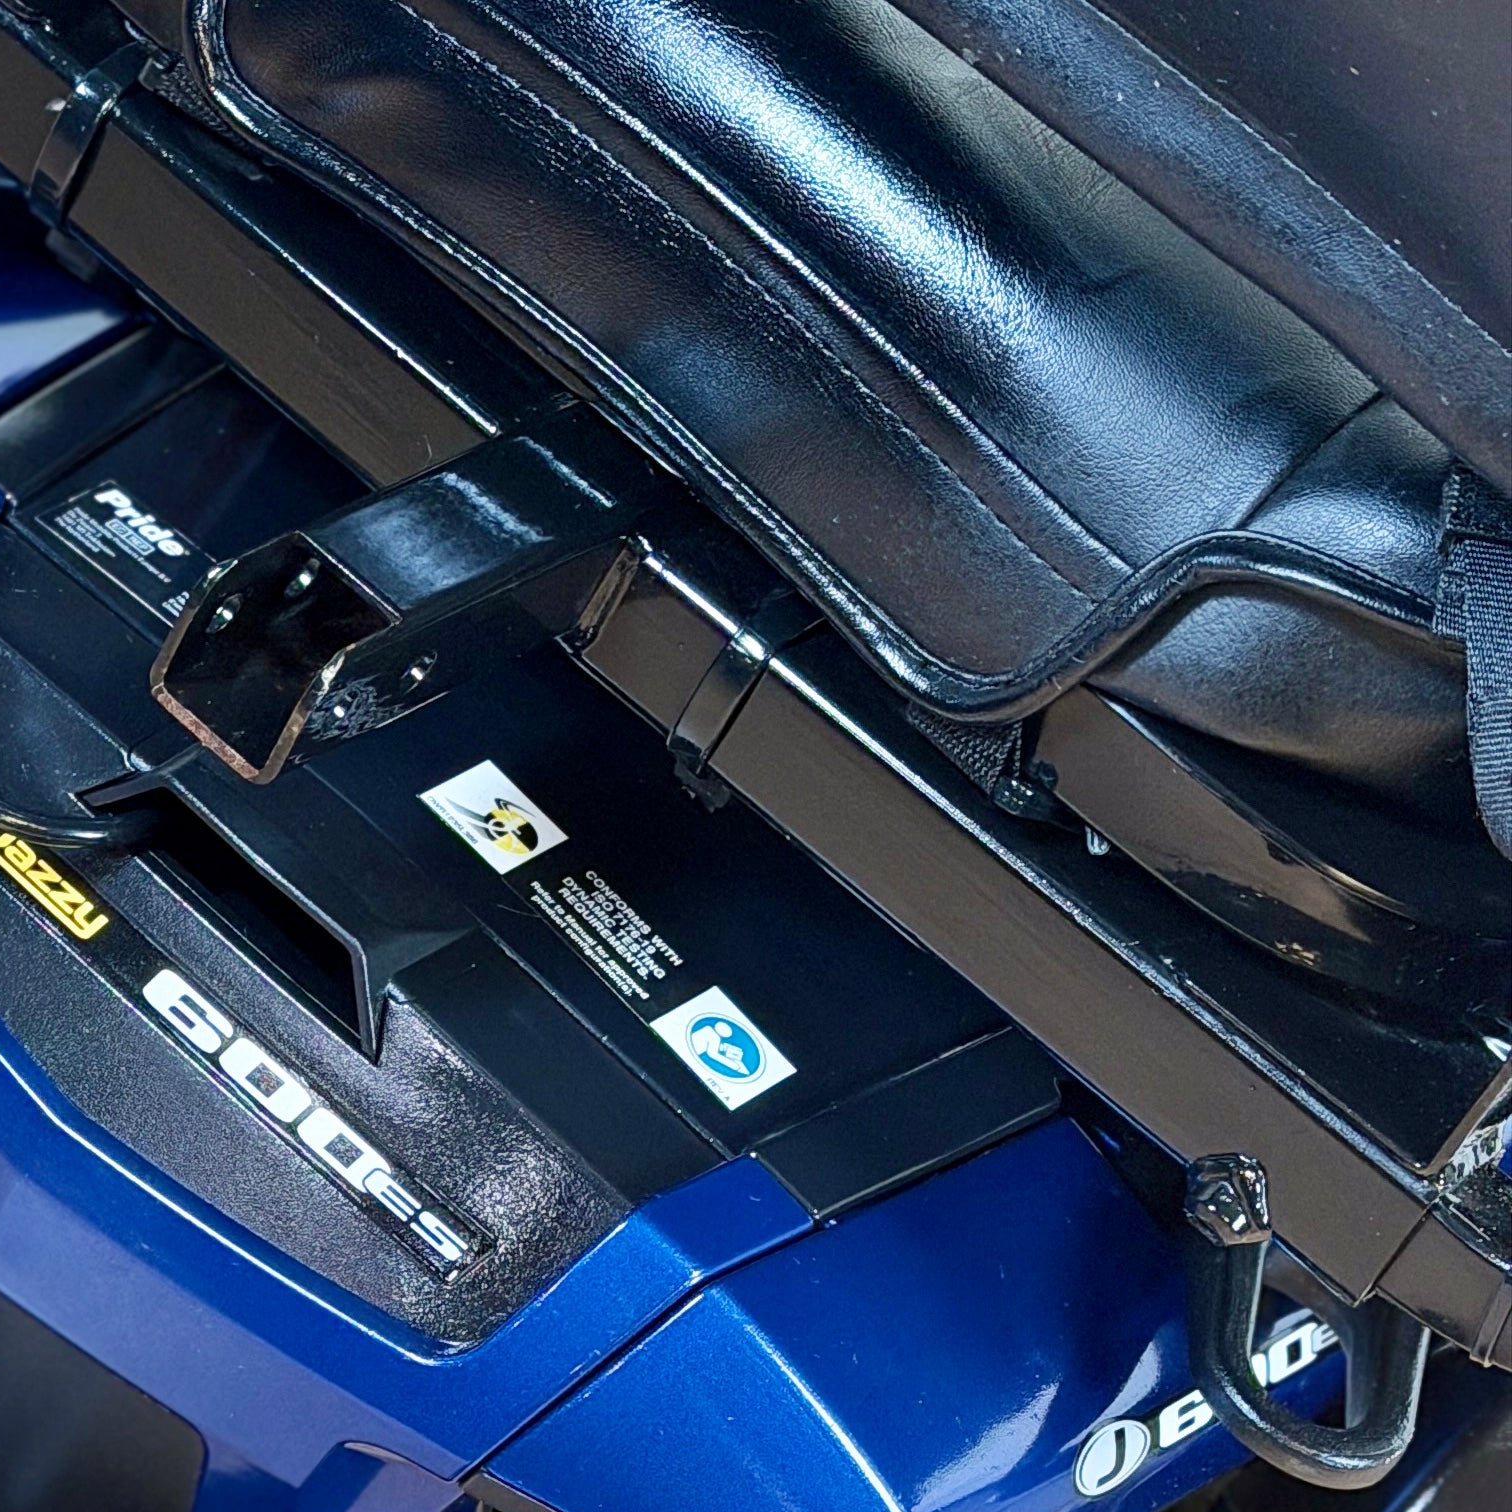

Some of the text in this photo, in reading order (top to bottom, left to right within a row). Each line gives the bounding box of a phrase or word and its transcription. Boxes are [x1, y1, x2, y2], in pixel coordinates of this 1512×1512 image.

[94, 489, 185, 556] Pride
[530, 895, 567, 929] product
[530, 880, 650, 1000] Refer to Manual for approved
[558, 887, 648, 980] REQUIREMENTS.
[562, 876, 666, 980] DYNAMIC TESTING
[585, 870, 684, 967] CONFORMS WITH
[591, 890, 657, 955] ISO 7176-19
[142, 969, 468, 1261] 600ES
